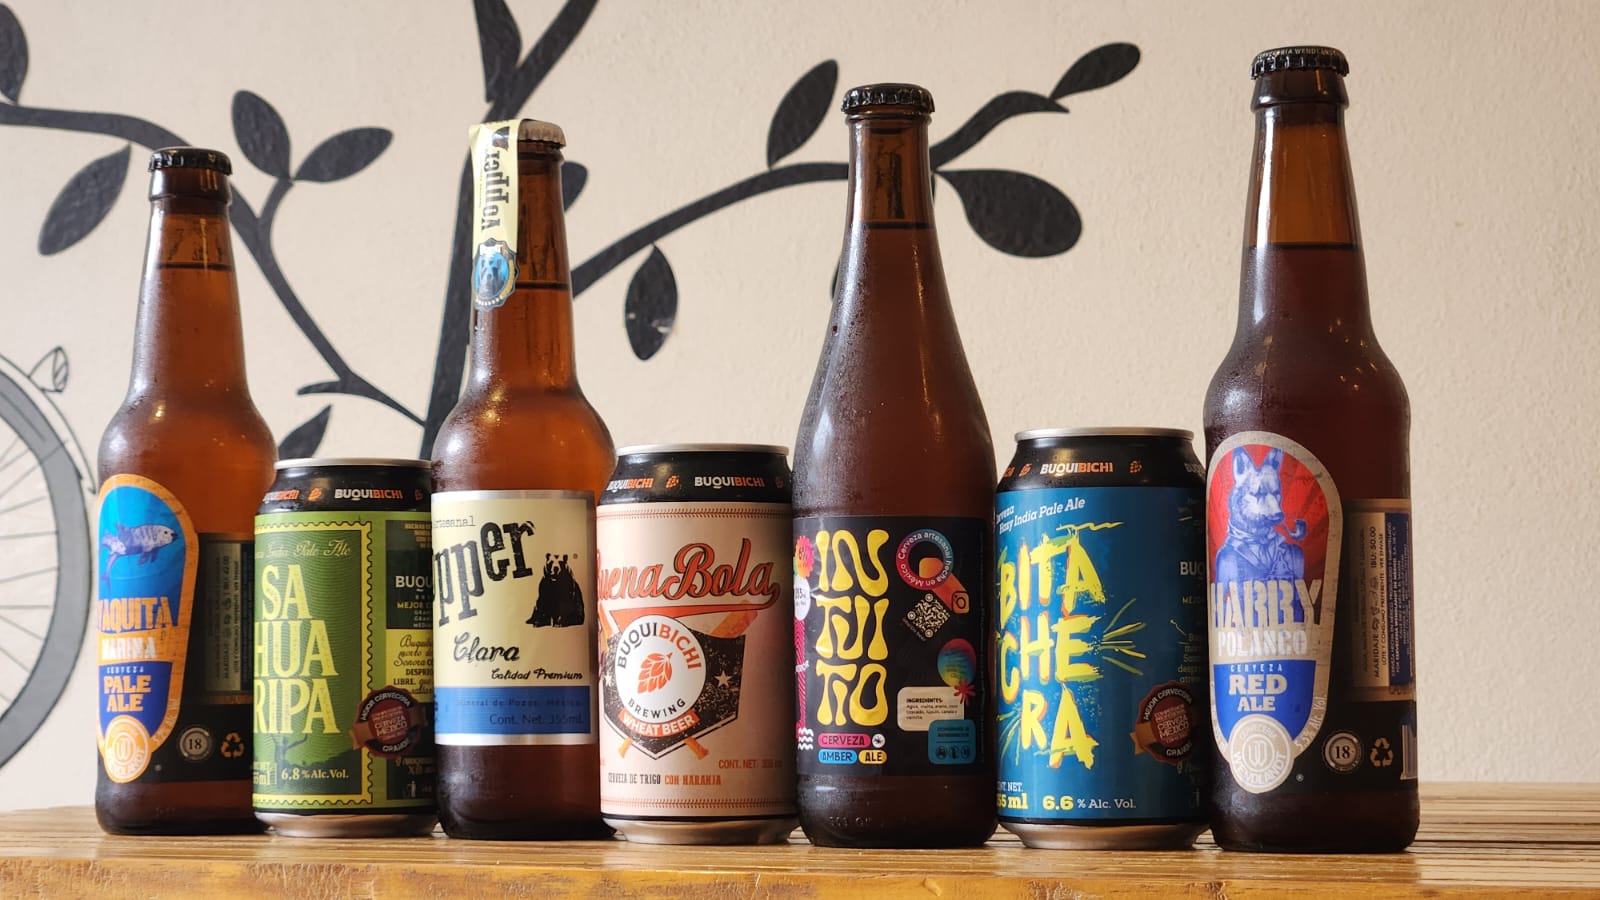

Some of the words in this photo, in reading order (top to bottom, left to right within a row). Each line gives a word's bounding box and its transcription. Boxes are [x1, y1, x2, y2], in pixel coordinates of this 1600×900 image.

[1040, 463, 1113, 476] BUQUIBICHI
[694, 476, 765, 489] BUQUIBICHI
[334, 489, 403, 501] BUQUIBICHI
[1014, 510, 1038, 527] India
[1039, 502, 1064, 518] Pale
[1064, 497, 1086, 512] Ale
[323, 539, 351, 557] Ale
[897, 532, 922, 560] Cerveza
[924, 531, 952, 559] artesanal
[433, 521, 535, 627] pper
[598, 563, 663, 600] uena
[664, 538, 779, 600] Bola
[1000, 534, 1106, 629] BITA
[262, 564, 312, 620] SA
[253, 619, 340, 677] HUA
[453, 632, 520, 663] Clara
[617, 622, 702, 669] BUQUIBICHI
[1001, 611, 1103, 703] CHE
[491, 668, 531, 680] Calidad
[533, 667, 583, 680] Premium
[1230, 664, 1283, 672] CERVEZA
[103, 675, 152, 694] PALE
[1229, 674, 1288, 695] RED
[106, 693, 144, 712] ALE
[253, 678, 341, 734] RIPA
[627, 697, 686, 719] BREWING
[1237, 696, 1276, 712] ALE
[490, 714, 519, 725] Cont.
[522, 714, 544, 725] Net.
[623, 712, 660, 736] WHEAT
[661, 714, 696, 735] BEER
[1020, 684, 1099, 769] RA
[189, 738, 201, 750] 18
[821, 736, 864, 746] CERVEZA
[822, 752, 852, 762] AMBER
[865, 752, 882, 762] ALE
[1334, 745, 1350, 760] 18
[718, 759, 741, 769] CONT.
[302, 769, 310, 778] %
[629, 773, 638, 784] DE
[640, 774, 661, 785] TRIGO
[664, 774, 679, 785] CON
[682, 774, 721, 785] NARANJA
[1007, 781, 1023, 792] NET.
[1042, 795, 1074, 811] 6.6
[1077, 798, 1086, 809] %
[1088, 798, 1111, 809] Alc.
[1114, 798, 1136, 809] Vol.
